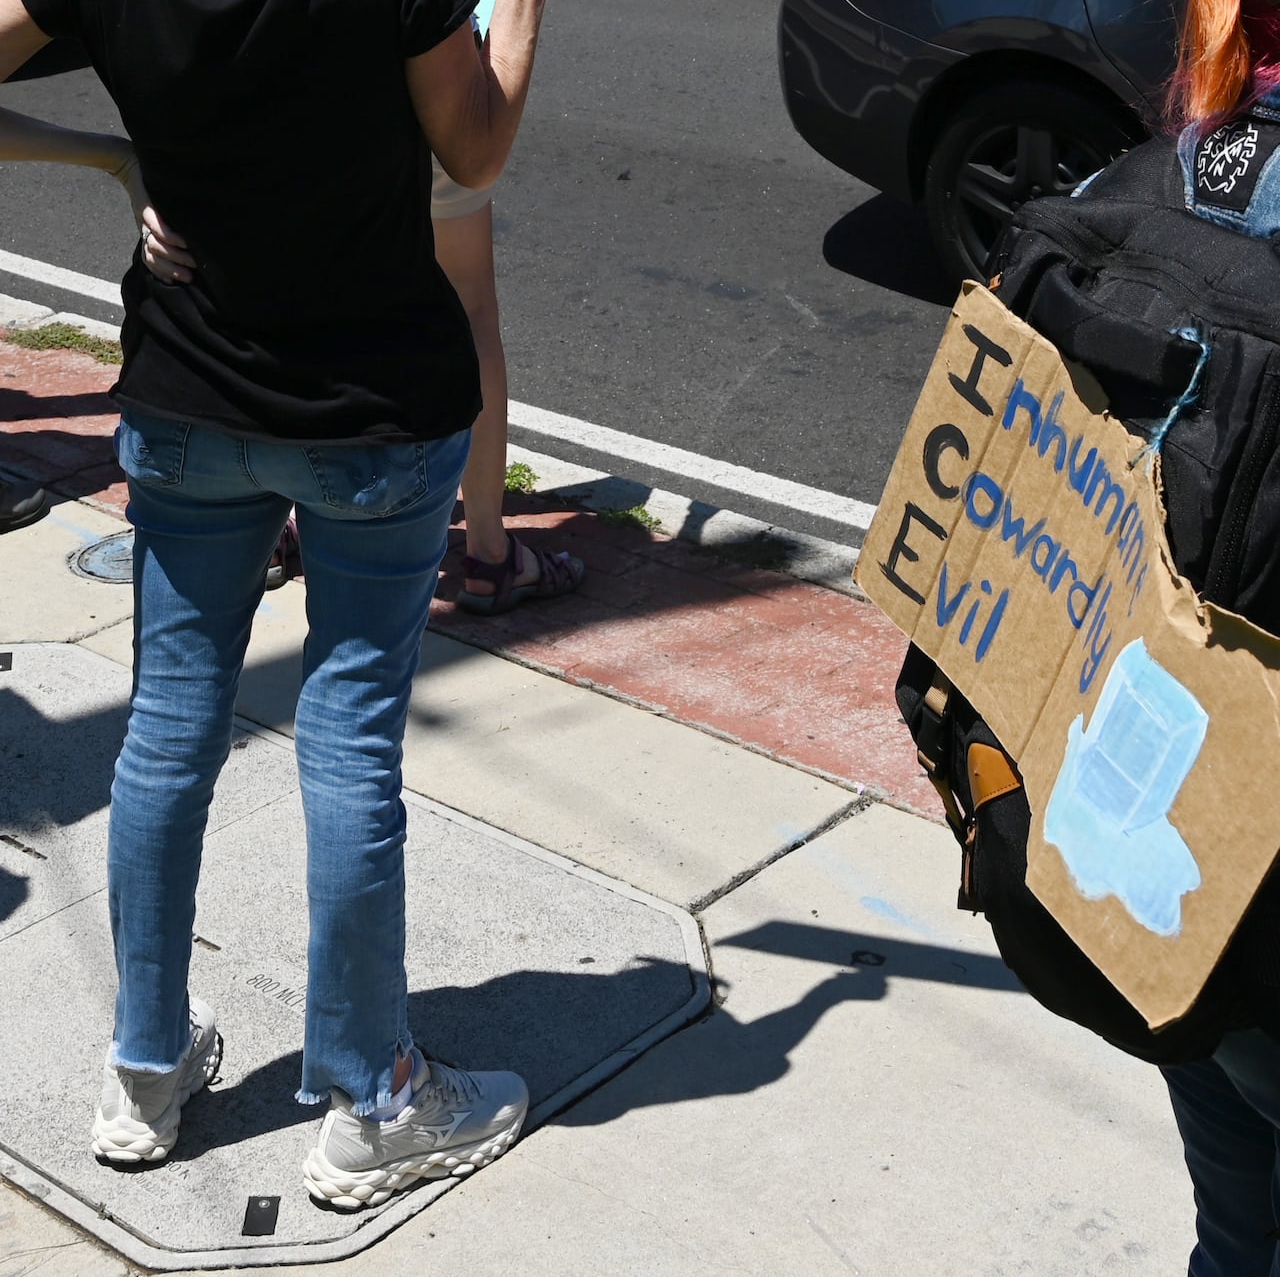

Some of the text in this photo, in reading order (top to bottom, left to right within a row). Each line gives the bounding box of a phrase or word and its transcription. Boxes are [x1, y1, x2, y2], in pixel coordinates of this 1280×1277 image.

[878, 501, 1009, 663] Evil
[923, 424, 1112, 694] Cowardly
[246, 974, 280, 993] 800
